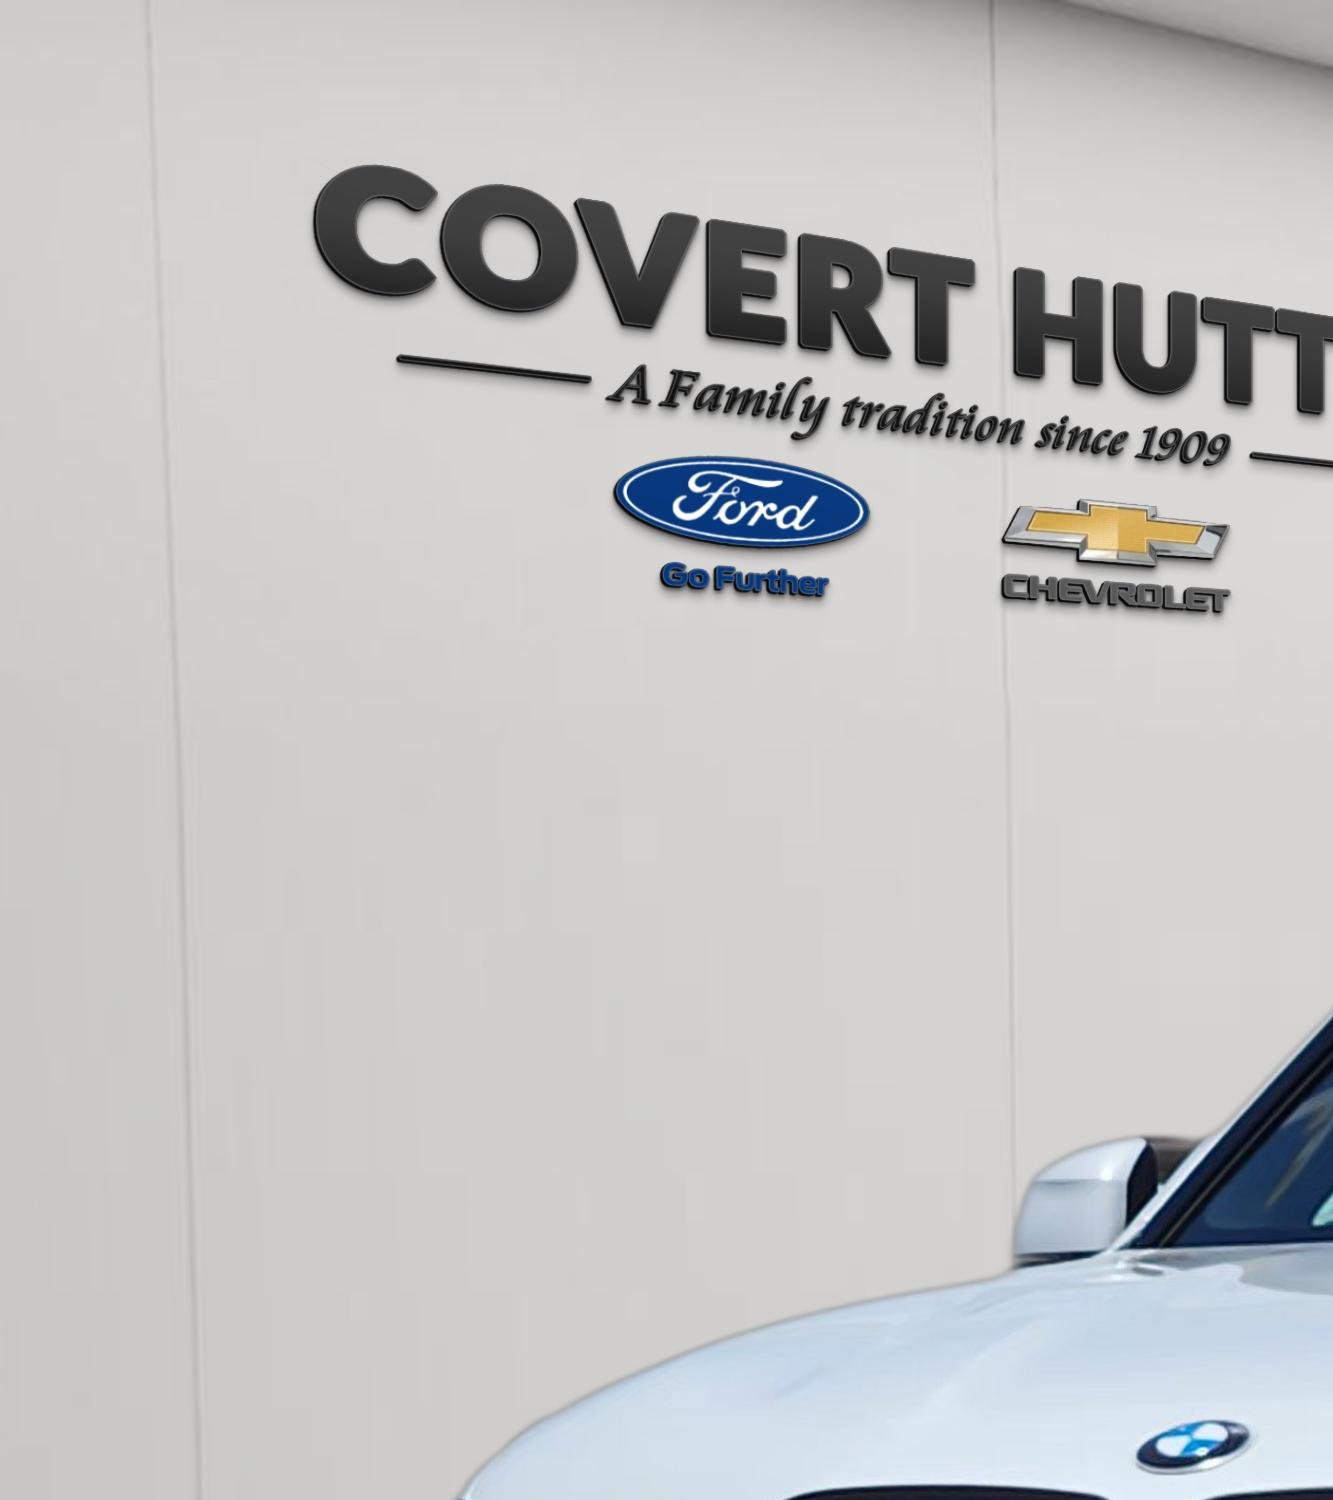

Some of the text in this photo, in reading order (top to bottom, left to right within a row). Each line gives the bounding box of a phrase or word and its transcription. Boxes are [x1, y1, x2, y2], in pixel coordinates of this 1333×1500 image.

[313, 165, 975, 368] COVERT
[605, 364, 1231, 467] A Family tradition since 1909
[672, 470, 818, 531] Ford
[660, 562, 830, 598] Go Further
[1001, 574, 1230, 615] CHEVROLET
